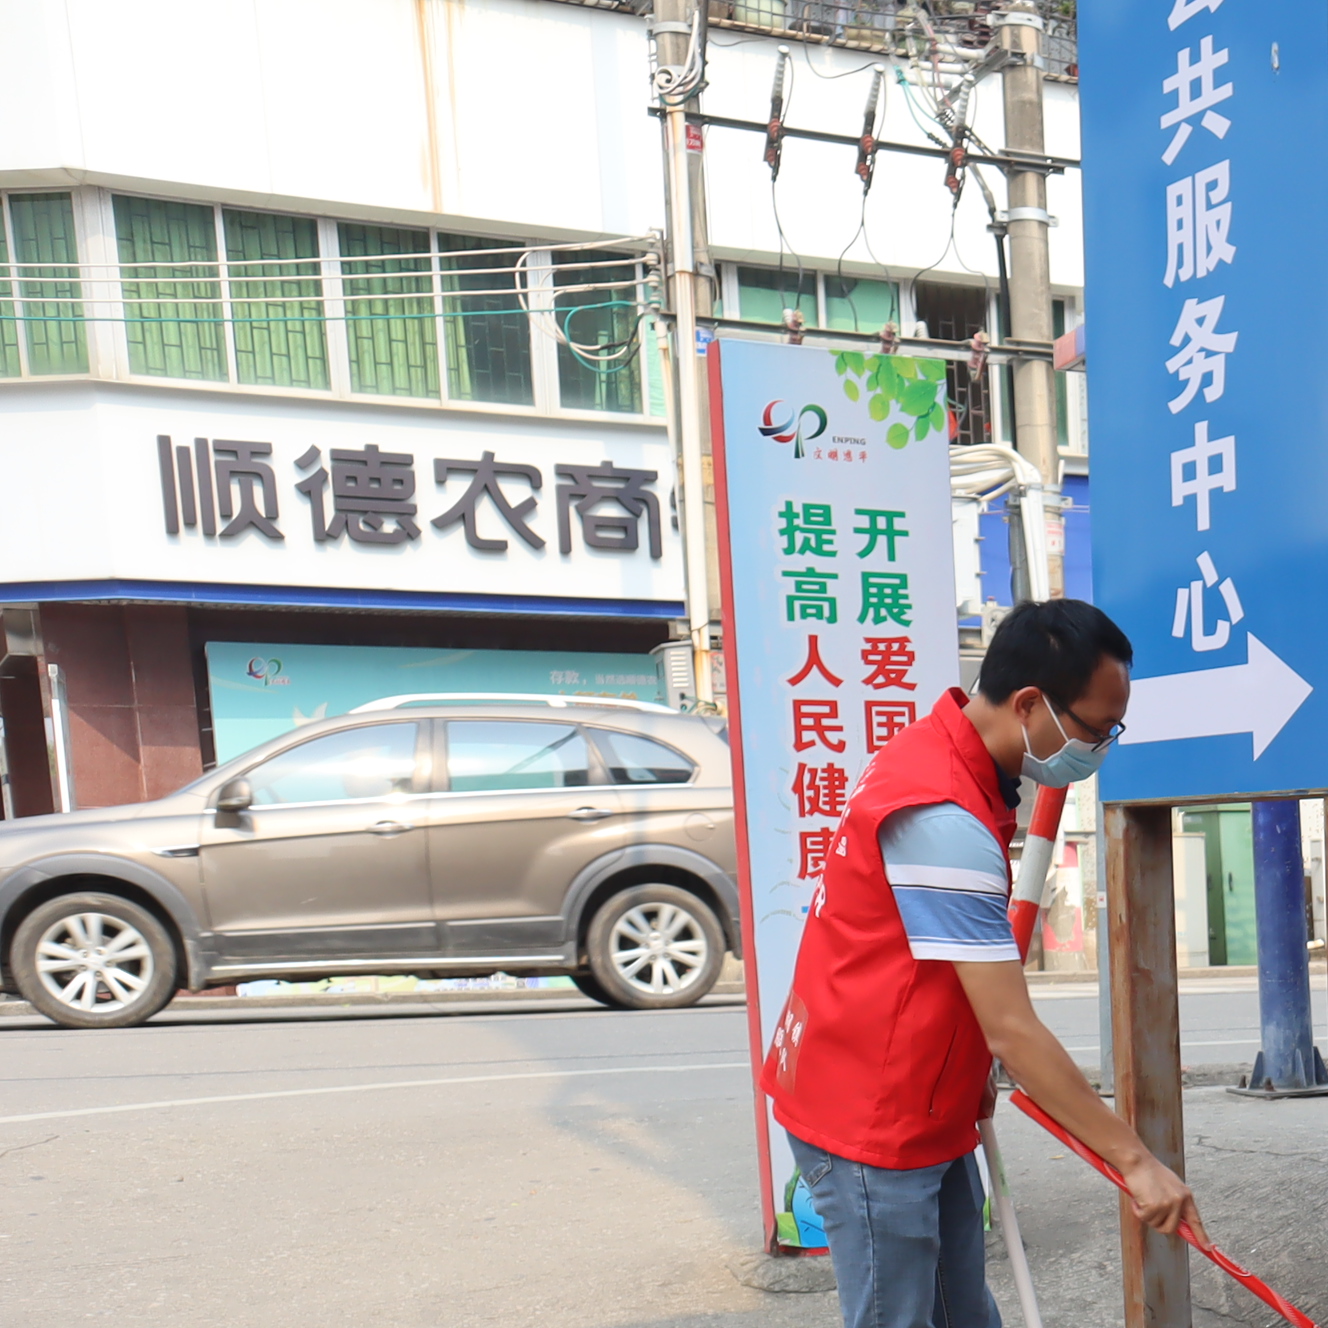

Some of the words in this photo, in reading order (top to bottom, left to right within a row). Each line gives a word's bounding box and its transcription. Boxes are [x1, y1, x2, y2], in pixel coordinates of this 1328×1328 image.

[1160, 0, 1244, 652] 共服务中心
[156, 434, 680, 560] 顺德农商
[832, 435, 867, 446] ENPING
